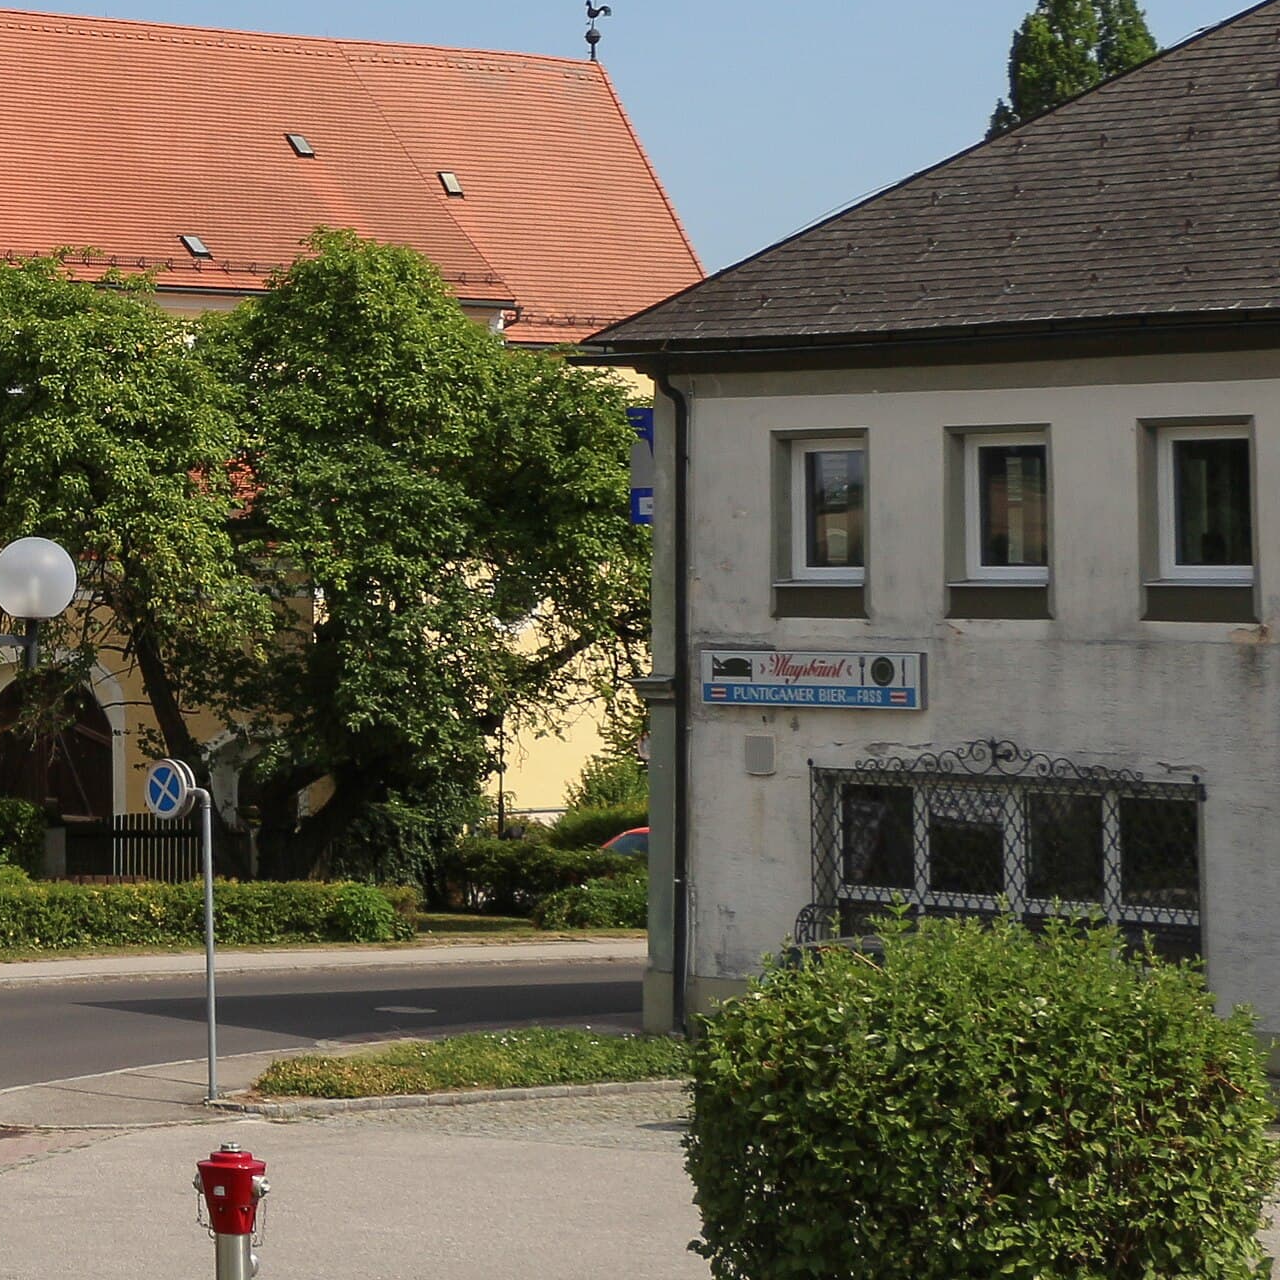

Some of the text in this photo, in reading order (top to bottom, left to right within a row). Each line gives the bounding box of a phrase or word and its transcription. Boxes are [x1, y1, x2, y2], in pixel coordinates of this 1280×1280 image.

[733, 686, 882, 703] PUNTIGAMER BIER FASS
